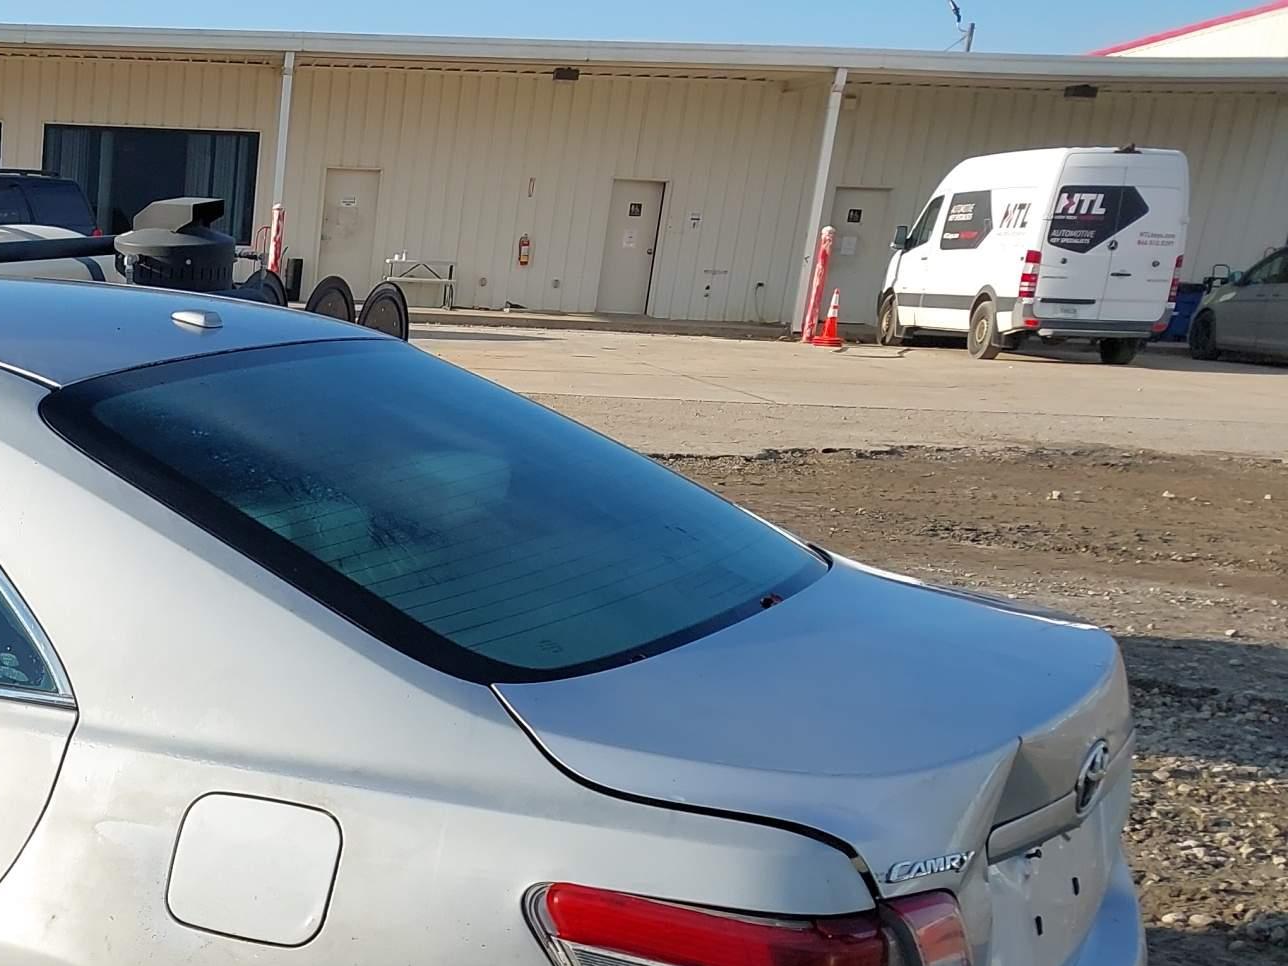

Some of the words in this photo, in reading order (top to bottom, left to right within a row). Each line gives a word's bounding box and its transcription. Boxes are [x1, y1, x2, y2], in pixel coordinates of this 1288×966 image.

[999, 203, 1032, 228] HTL
[1054, 193, 1107, 215] HTL
[1051, 229, 1097, 239] AUTOMOTIVE
[886, 849, 976, 885] CAMRY
